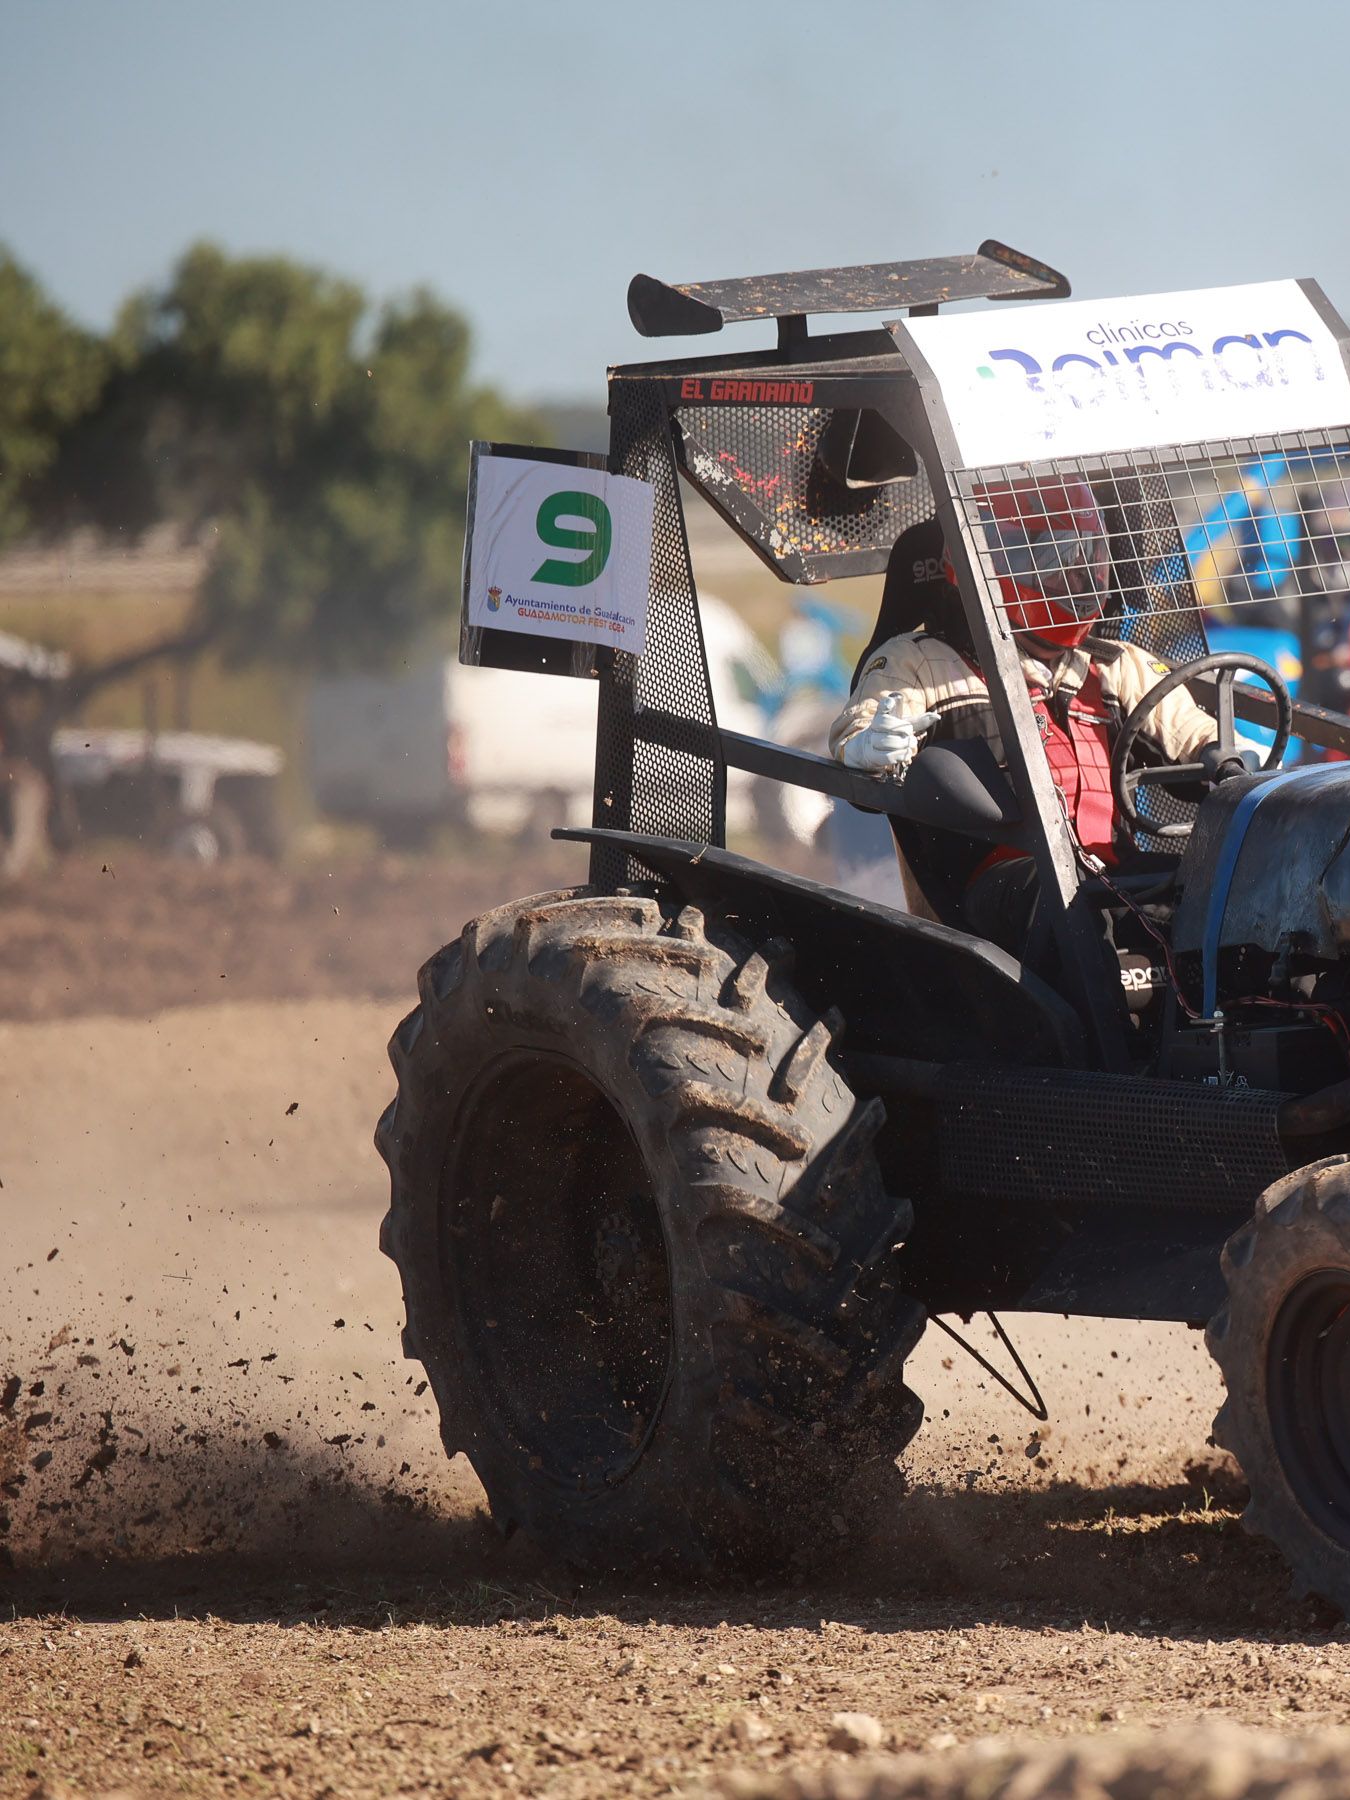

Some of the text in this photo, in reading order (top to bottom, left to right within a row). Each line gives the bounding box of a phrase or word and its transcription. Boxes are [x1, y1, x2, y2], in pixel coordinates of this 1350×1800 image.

[681, 378, 704, 399] EL
[530, 490, 612, 587] 9
[505, 595, 576, 614] Ayuntamiento
[579, 605, 592, 615] de
[518, 608, 586, 626] GUADAMOTOR
[588, 617, 607, 630] FEST
